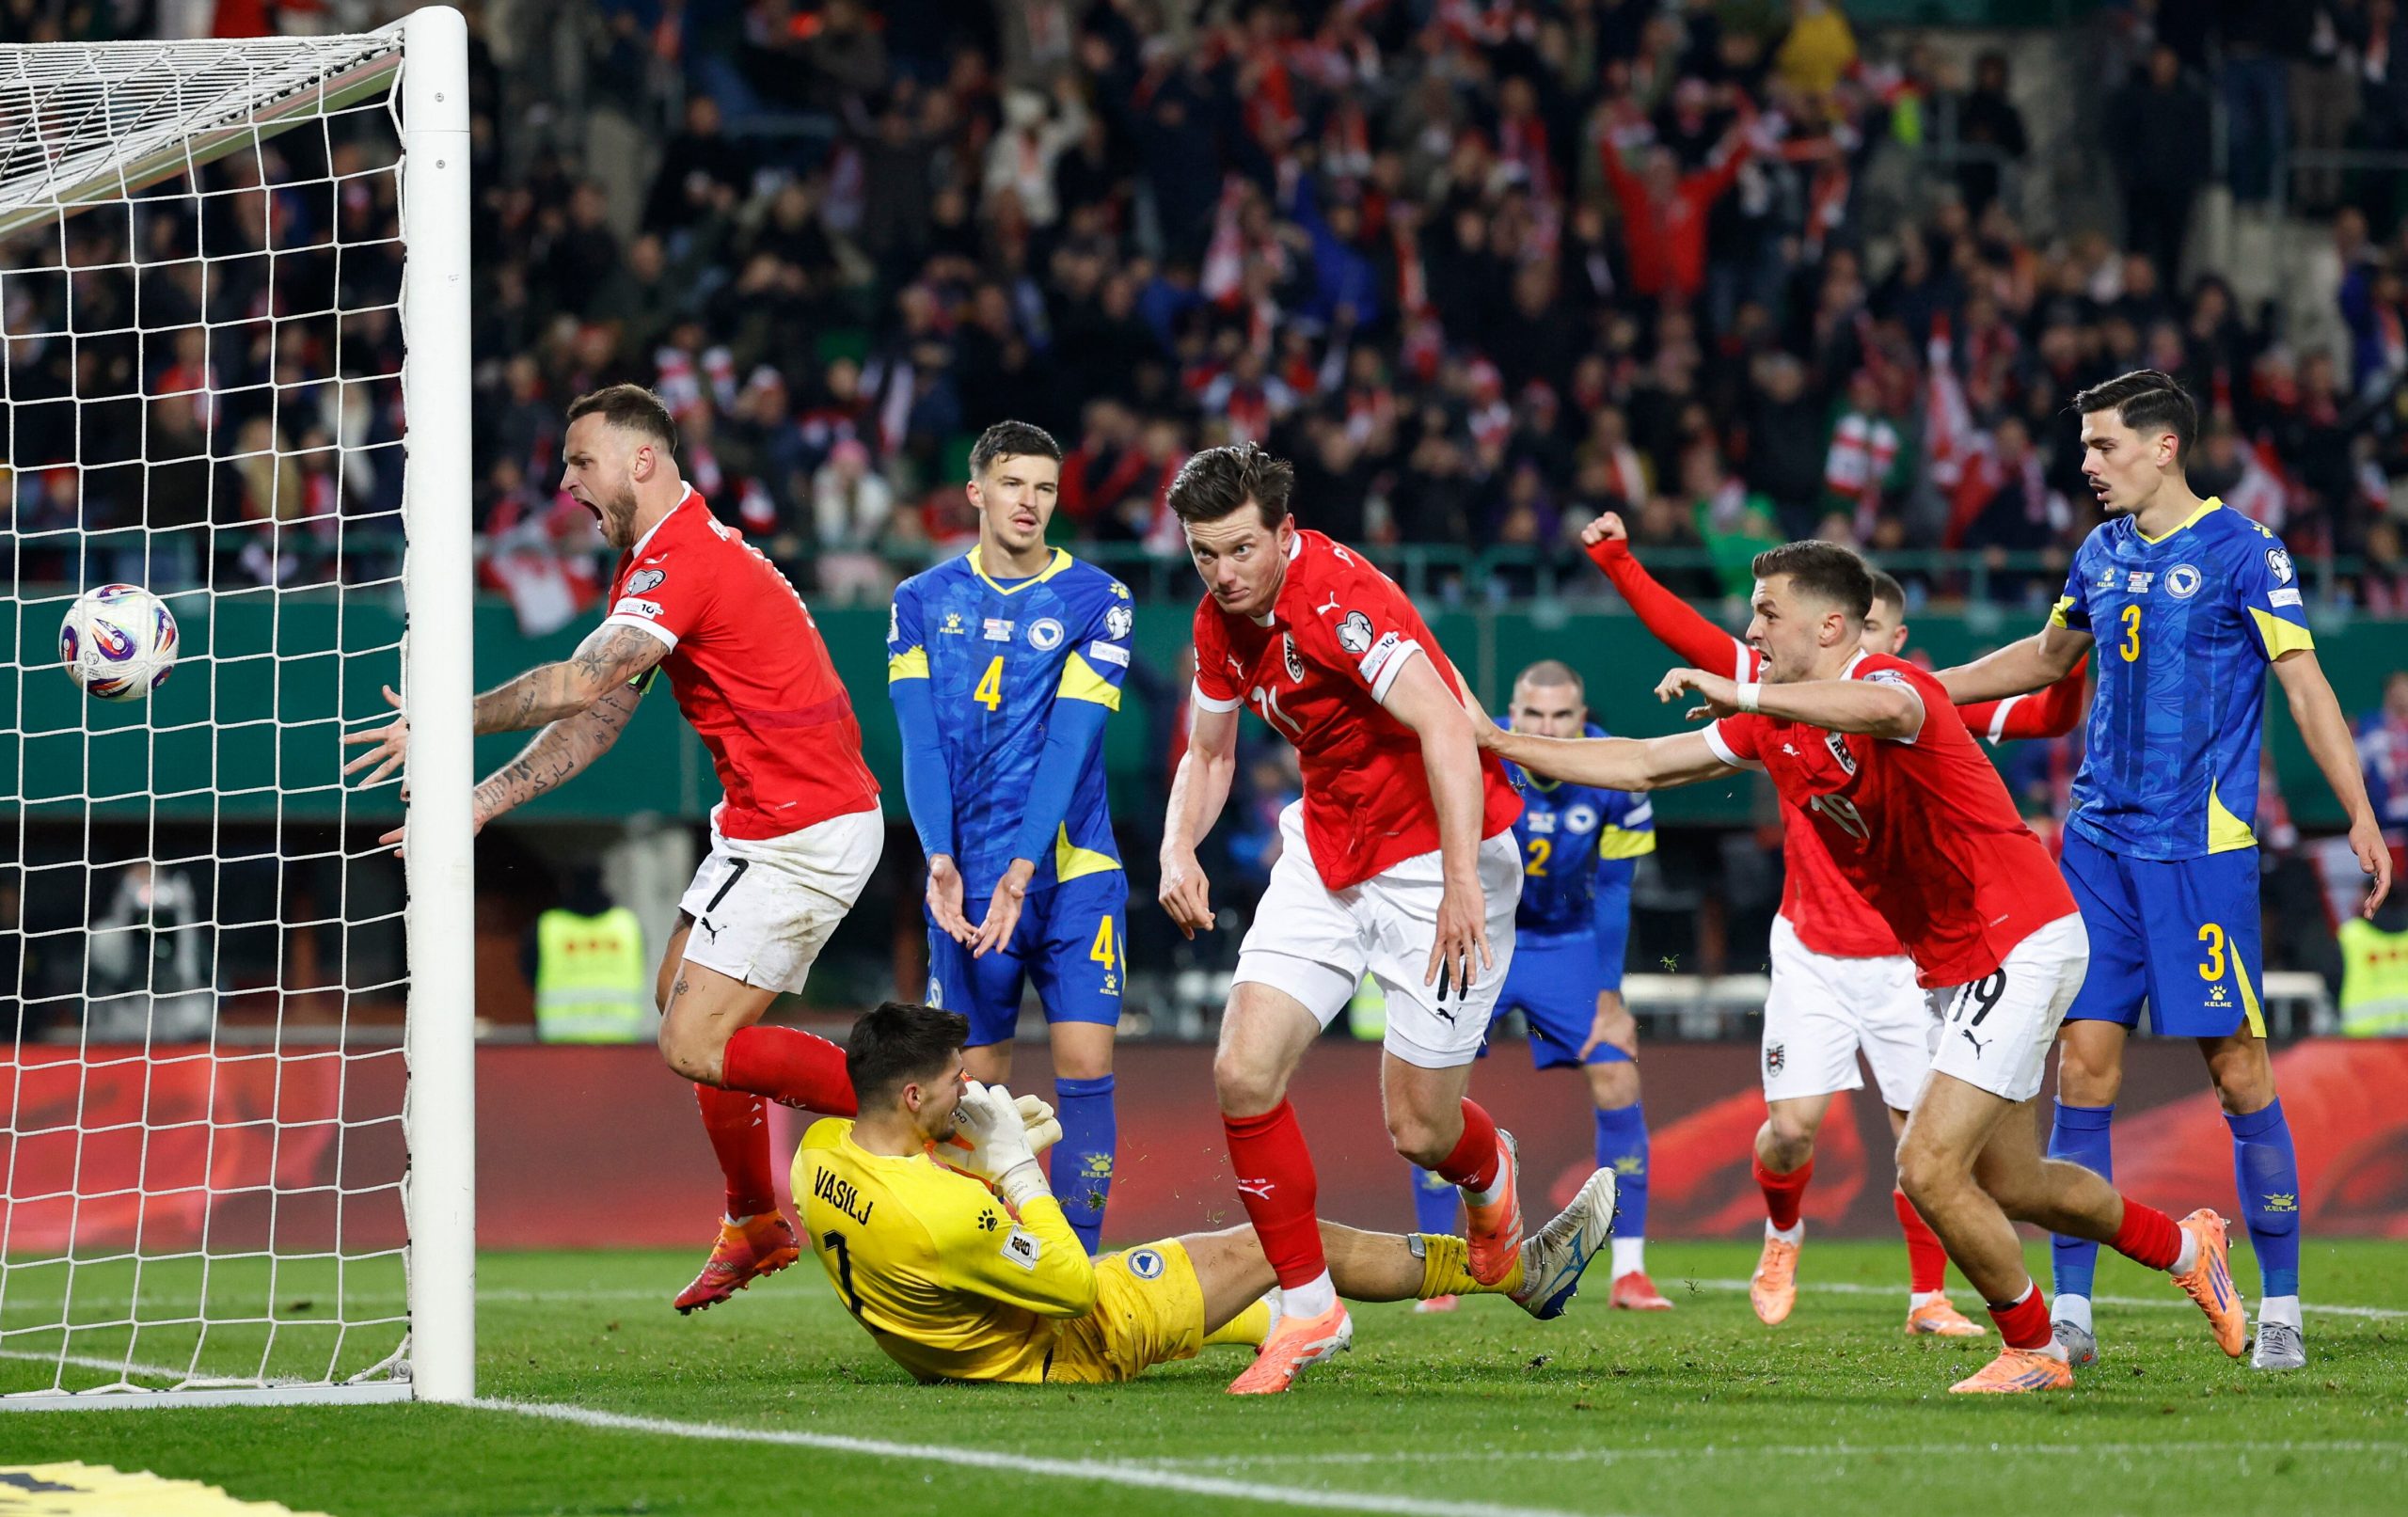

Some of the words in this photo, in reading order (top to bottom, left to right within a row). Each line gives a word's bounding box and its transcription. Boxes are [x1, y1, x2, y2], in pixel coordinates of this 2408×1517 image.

[2120, 604, 2141, 662] 3
[974, 656, 1004, 711] 4
[705, 857, 749, 912] 7
[1525, 838, 1552, 877] 2
[1090, 915, 1115, 971] 4
[2198, 923, 2225, 981] 3
[1953, 967, 2006, 1027] 19
[814, 1166, 874, 1225] VASILJ
[823, 1229, 863, 1317] 1
